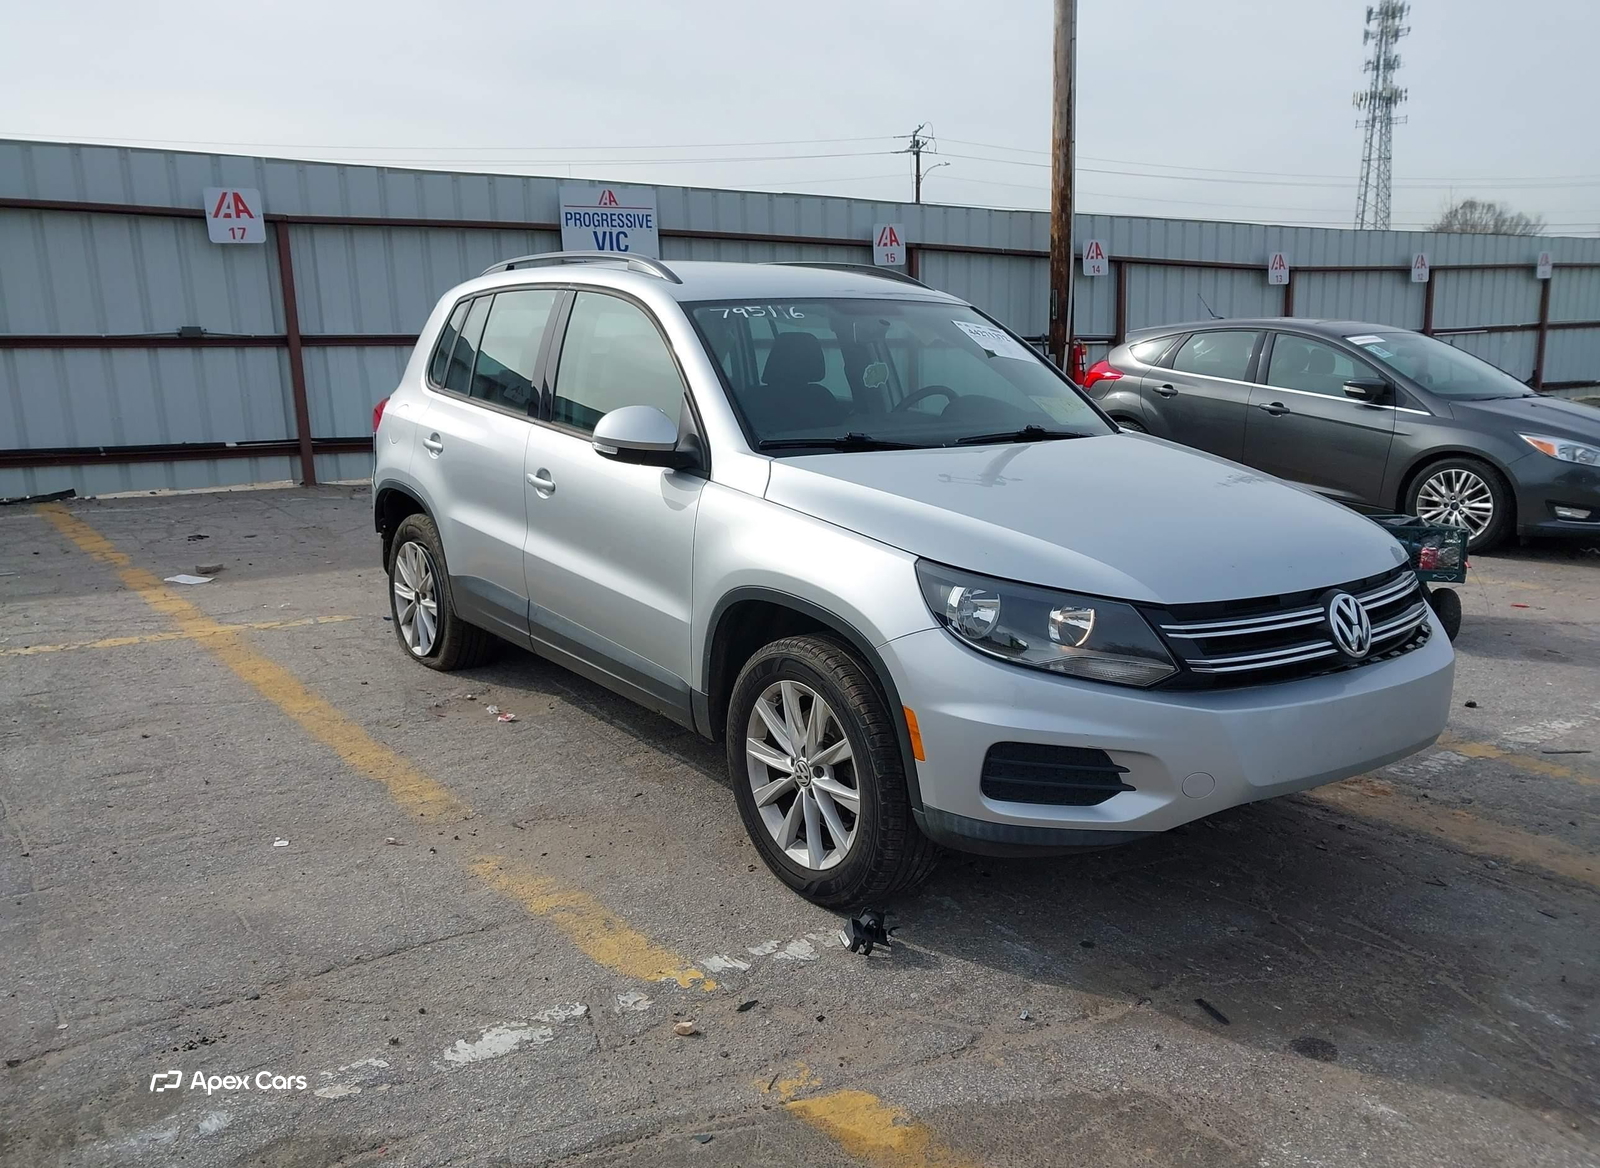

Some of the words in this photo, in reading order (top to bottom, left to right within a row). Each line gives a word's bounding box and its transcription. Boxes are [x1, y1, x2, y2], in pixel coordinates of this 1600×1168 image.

[565, 212, 652, 228] PROGRESSIVE
[228, 227, 246, 240] 17
[592, 230, 629, 252] VIC
[885, 253, 896, 263] 15
[1092, 265, 1101, 274] 14
